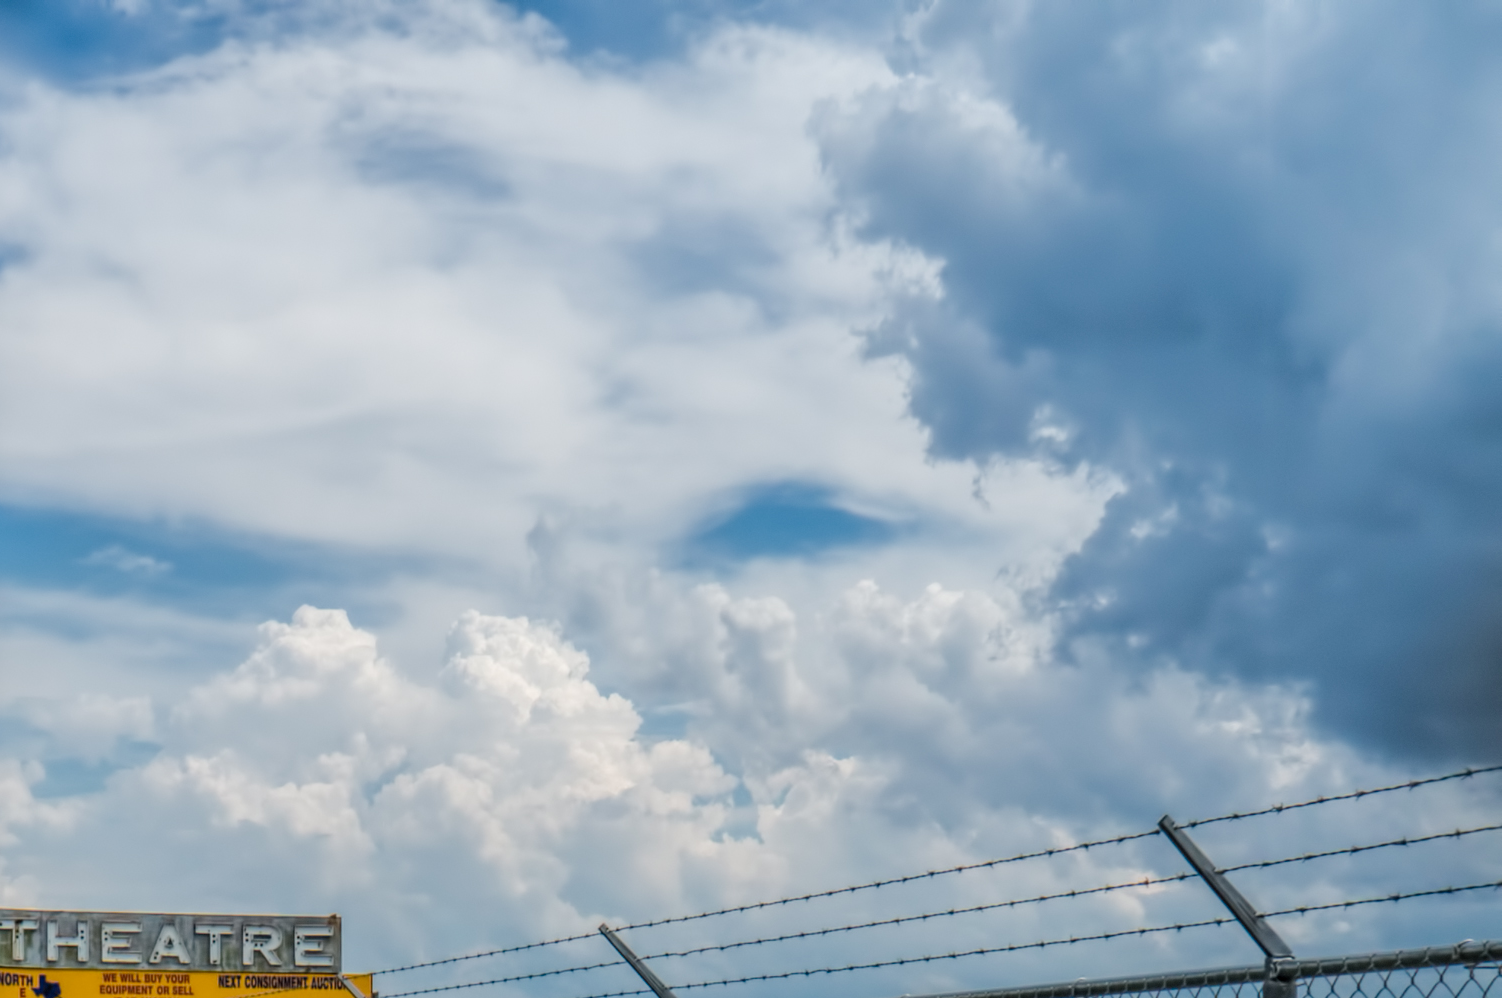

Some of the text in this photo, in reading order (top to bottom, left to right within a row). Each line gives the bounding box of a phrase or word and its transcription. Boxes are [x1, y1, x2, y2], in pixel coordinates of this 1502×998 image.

[103, 973, 190, 983] WE WILL BUY YOUR
[219, 975, 242, 988] NEXT
[245, 975, 308, 989] CONSIGNMENT
[100, 985, 194, 995] EQUIPMENT OR SELL
